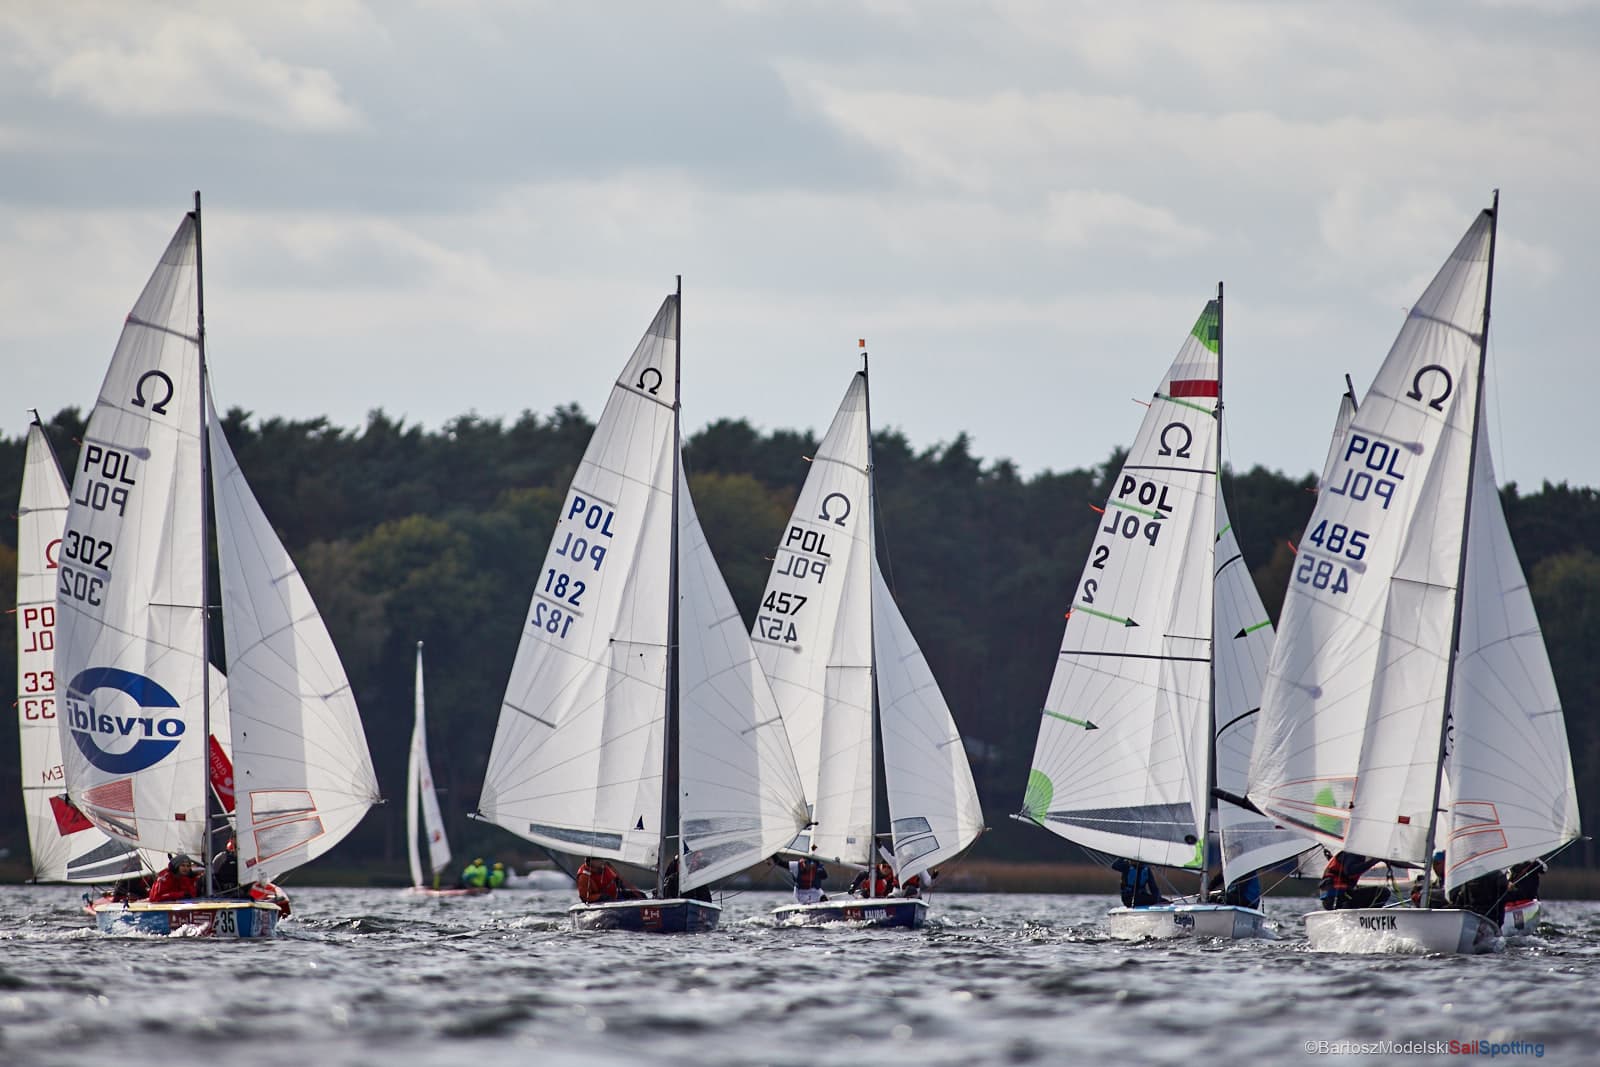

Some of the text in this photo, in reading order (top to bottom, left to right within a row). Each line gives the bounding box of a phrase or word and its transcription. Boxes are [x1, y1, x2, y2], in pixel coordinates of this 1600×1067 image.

[83, 445, 136, 485] POL
[1344, 434, 1405, 480] POL
[1118, 475, 1173, 512] POL
[567, 496, 615, 538] POL
[65, 530, 113, 571] 302
[785, 526, 831, 557] POL
[1092, 545, 1109, 570] 2
[1309, 519, 1370, 561] 485
[543, 568, 586, 606] 182
[763, 590, 807, 616] 457
[24, 607, 55, 629] PO
[221, 911, 235, 933] 35
